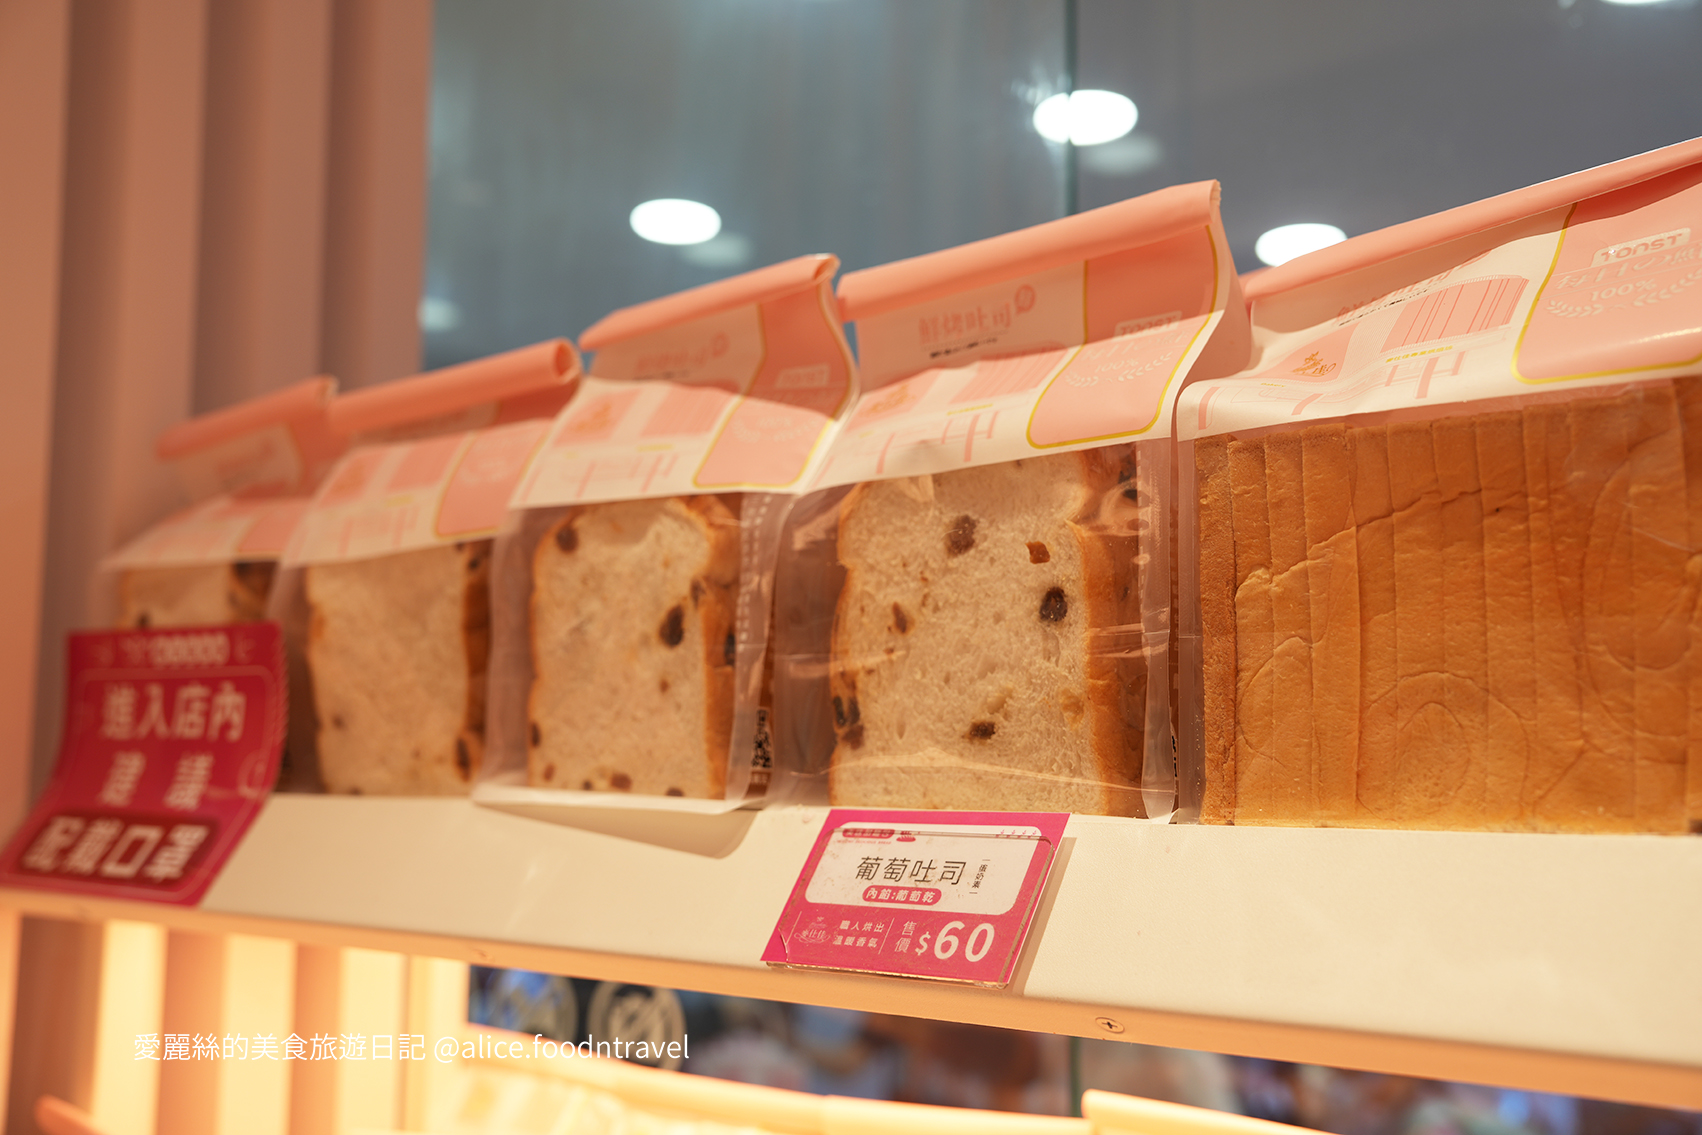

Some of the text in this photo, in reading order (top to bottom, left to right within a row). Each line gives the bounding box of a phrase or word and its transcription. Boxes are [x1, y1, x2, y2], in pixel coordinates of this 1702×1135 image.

[1591, 279, 1657, 302] 100%
[856, 856, 967, 886] 葡萄吐司
[915, 919, 995, 962] $60
